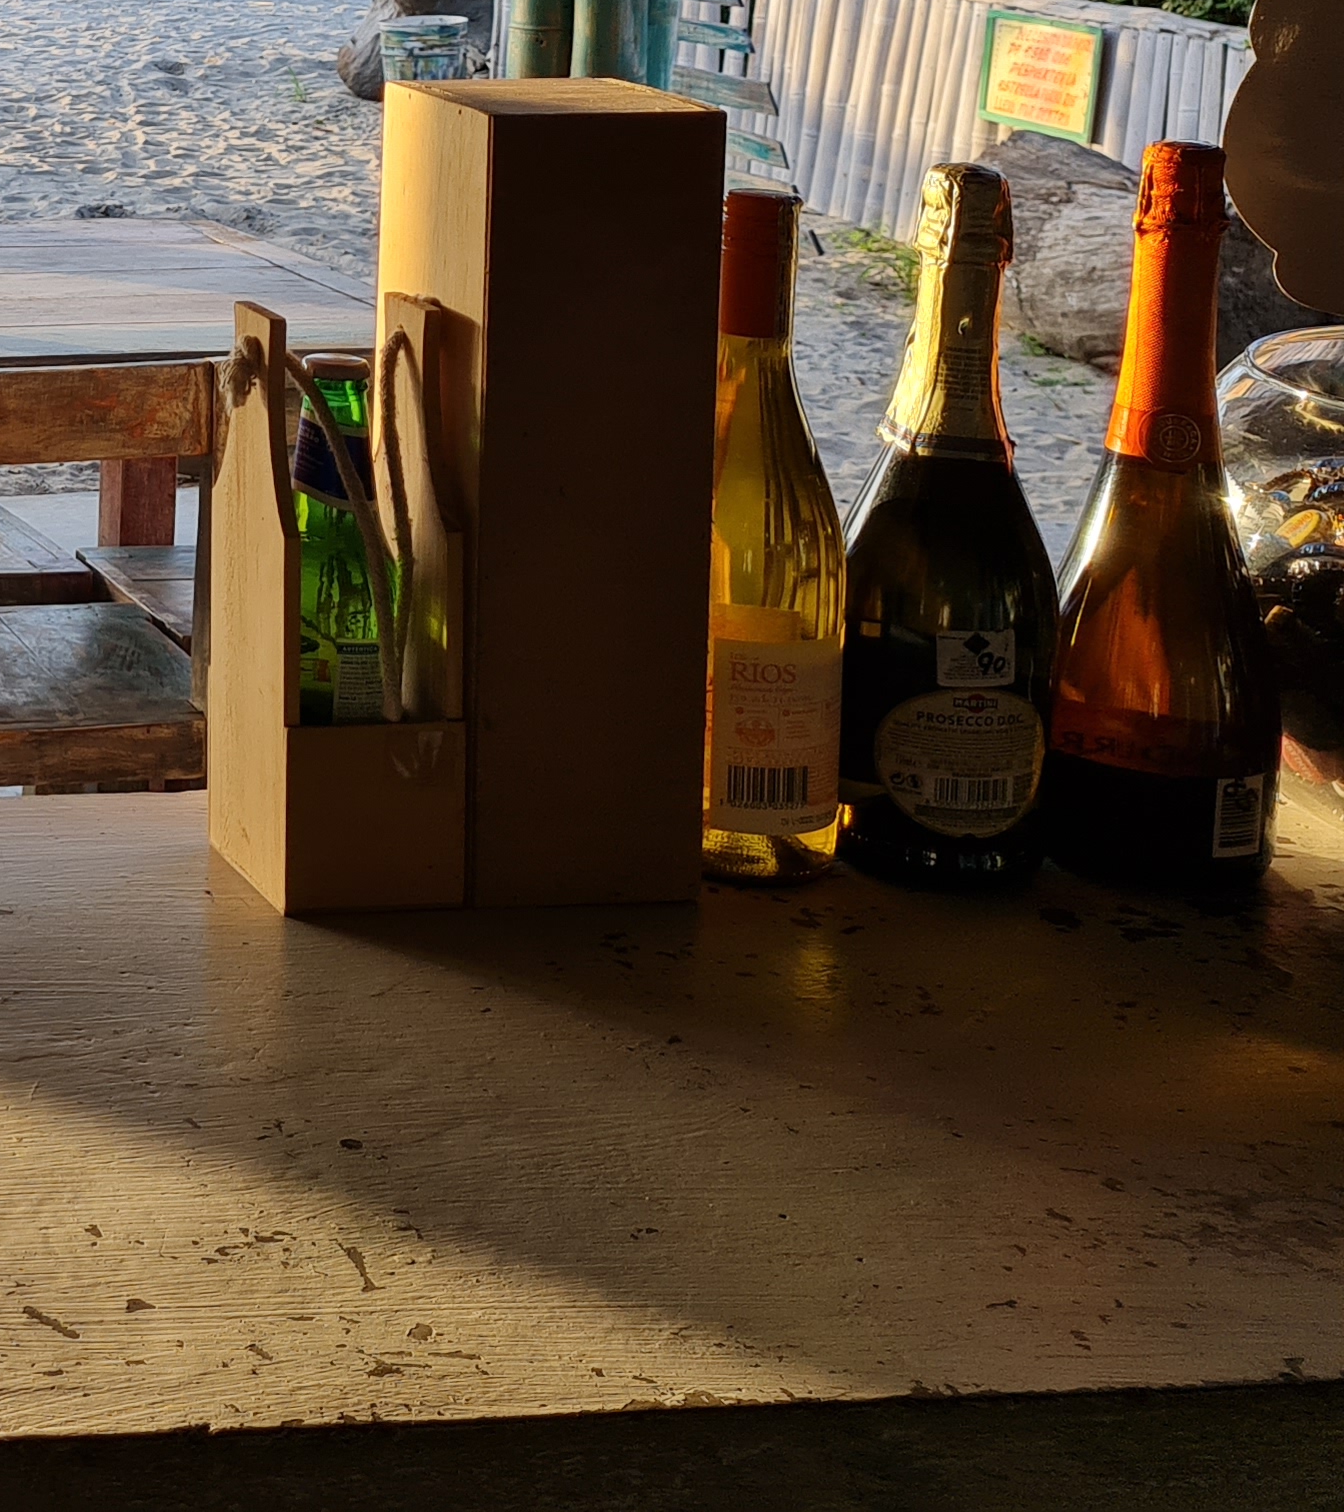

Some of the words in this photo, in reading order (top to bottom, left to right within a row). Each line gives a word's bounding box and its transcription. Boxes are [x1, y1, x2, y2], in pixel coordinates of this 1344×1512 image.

[729, 656, 797, 684] RÍOS
[977, 651, 1006, 675] 90
[955, 698, 997, 708] MARTINI
[916, 711, 994, 727] PROSECCO
